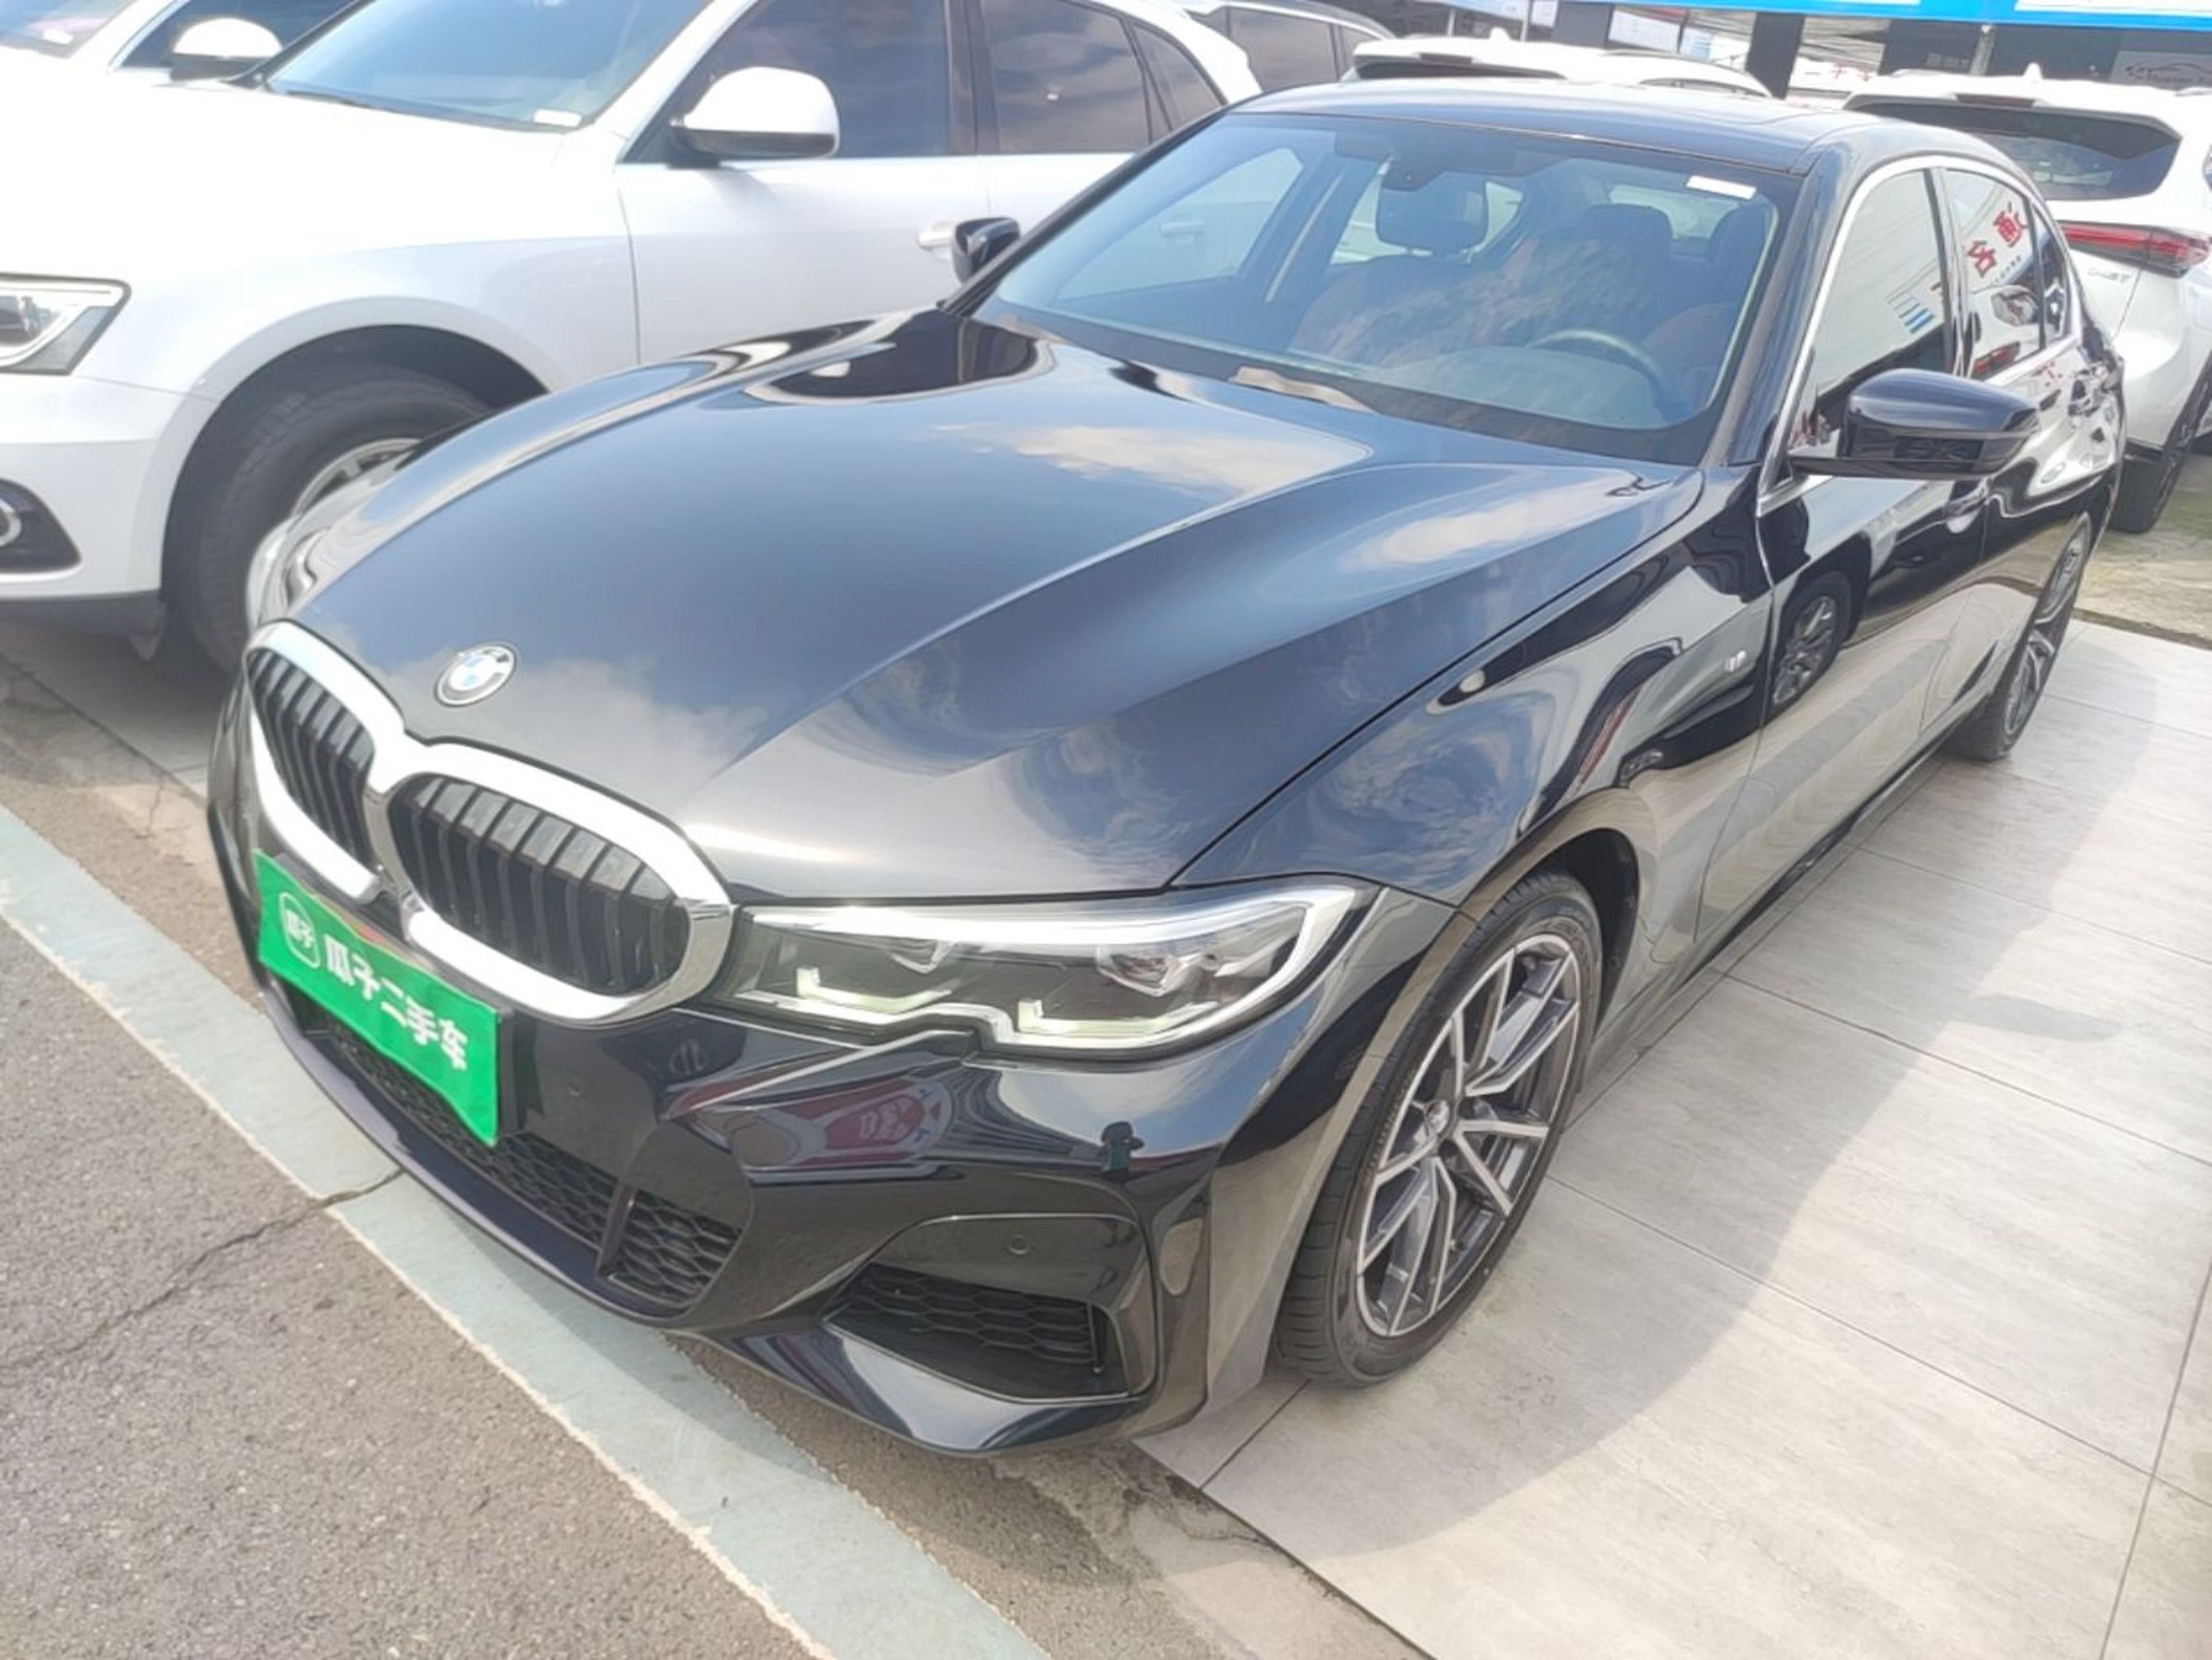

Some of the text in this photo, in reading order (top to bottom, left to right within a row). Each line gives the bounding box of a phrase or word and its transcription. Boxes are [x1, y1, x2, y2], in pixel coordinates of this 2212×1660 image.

[324, 932, 468, 1071] 瓜子二手车
